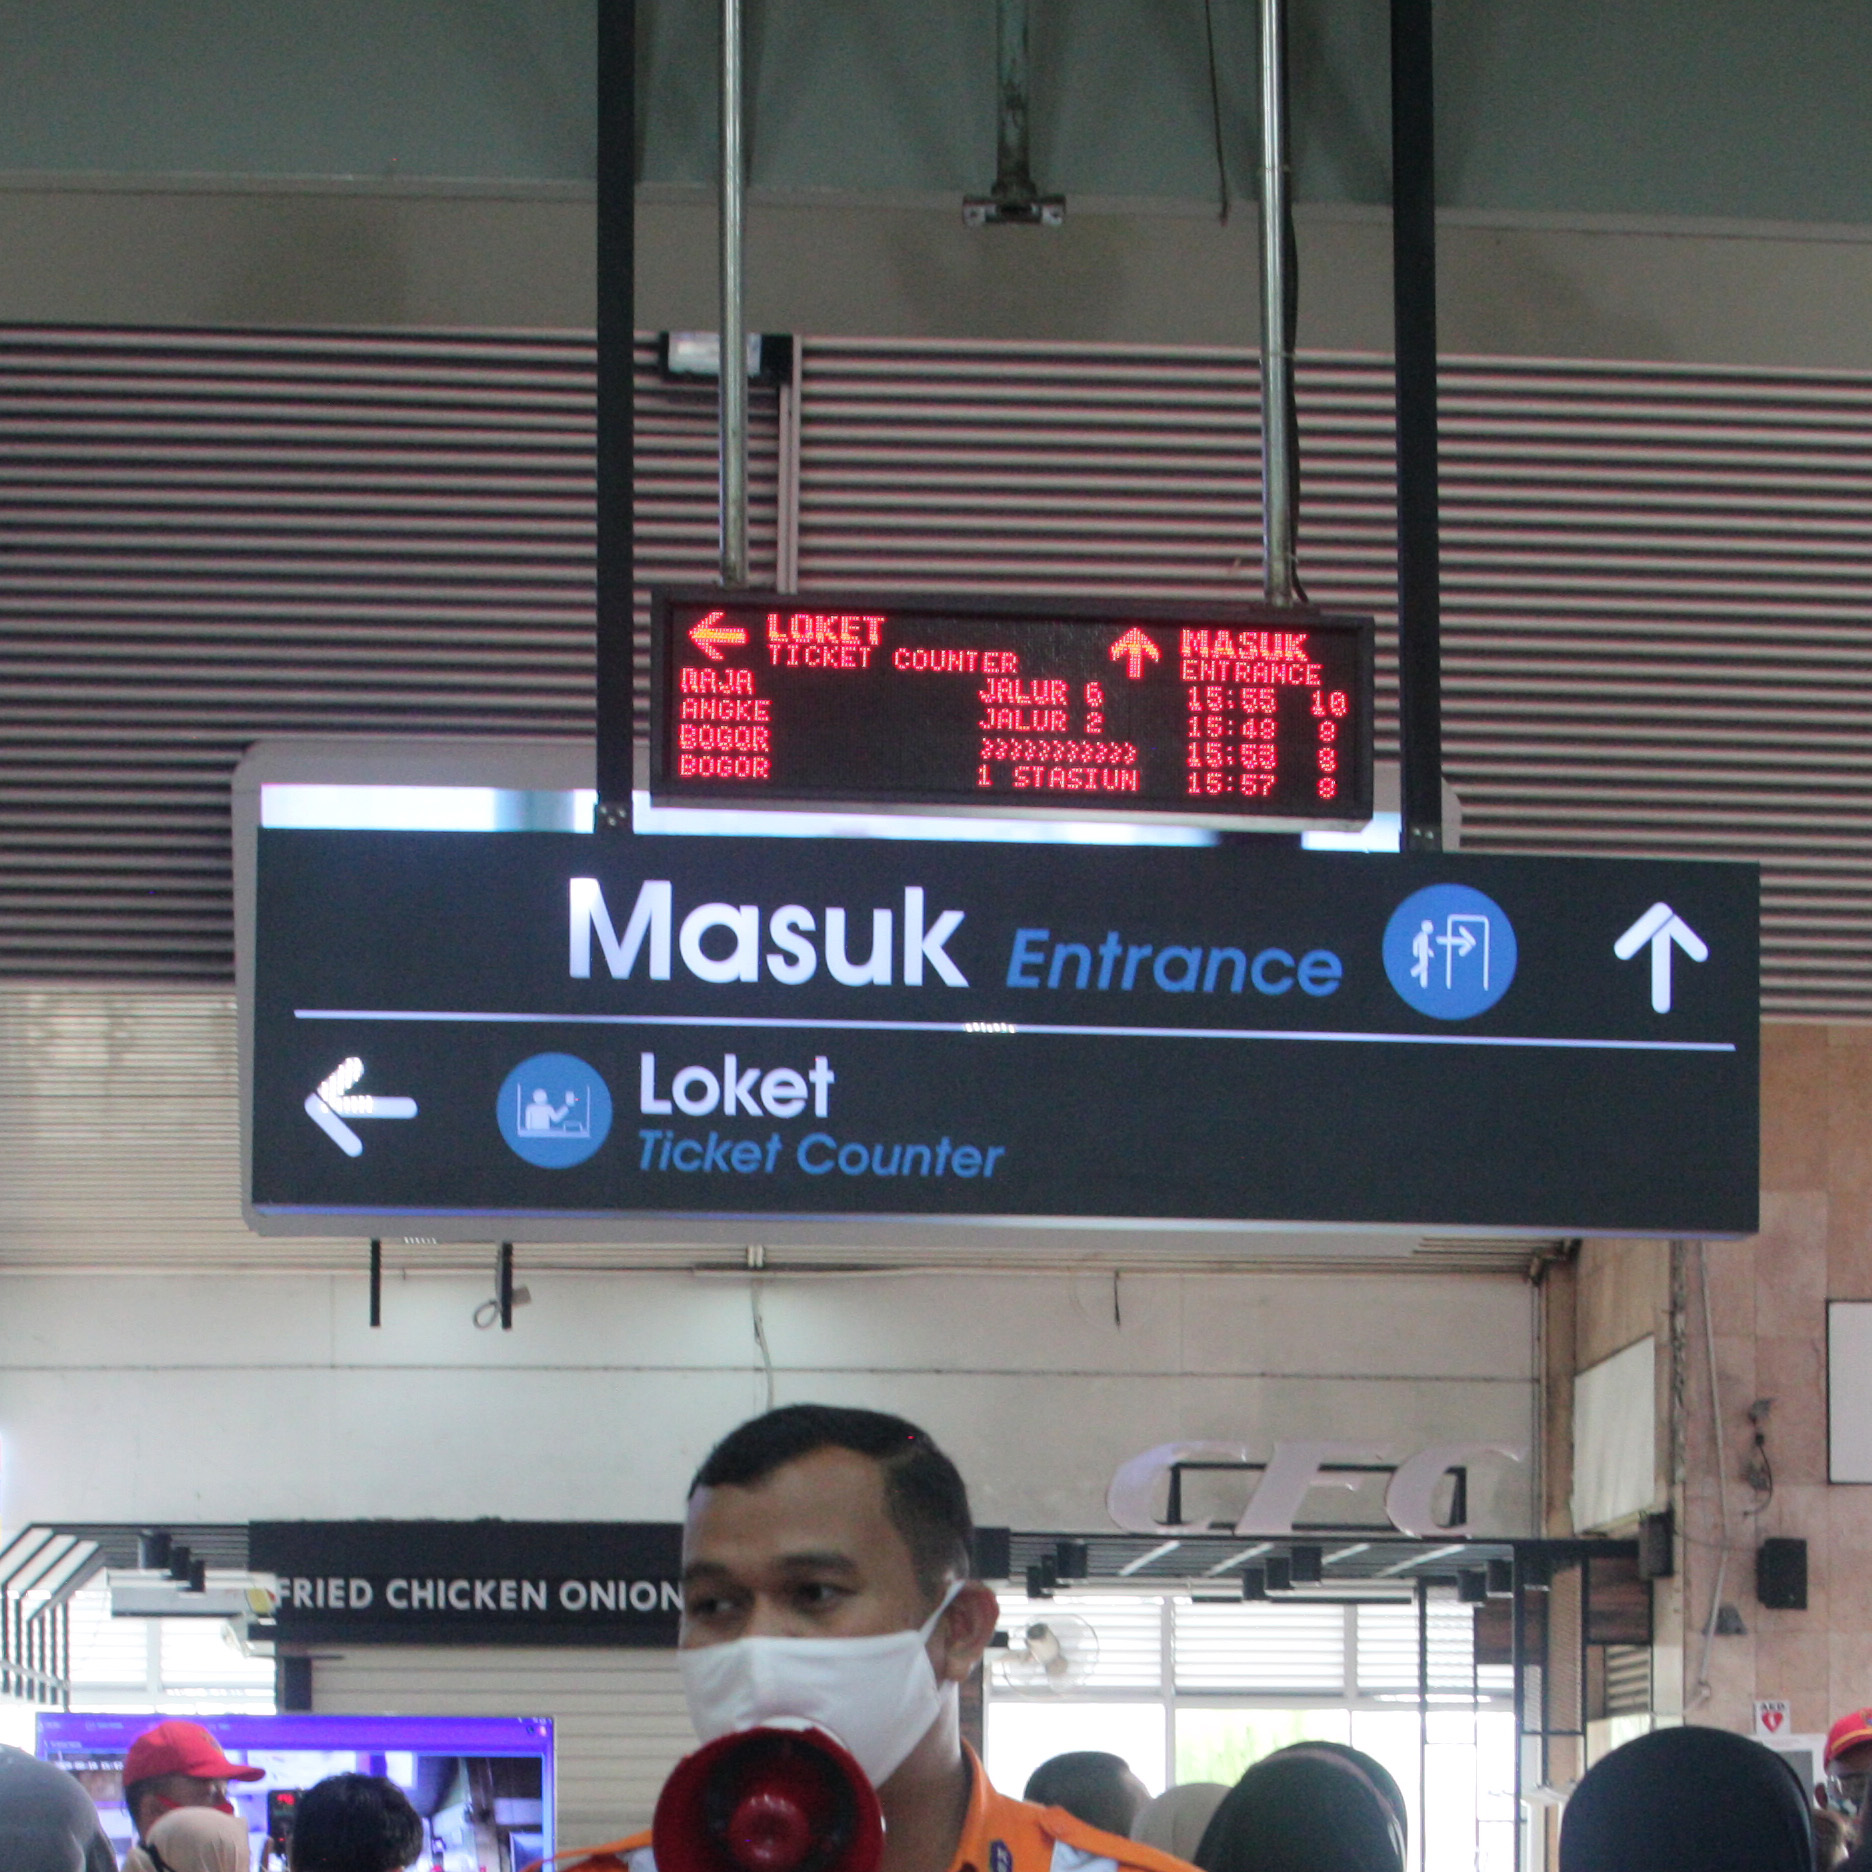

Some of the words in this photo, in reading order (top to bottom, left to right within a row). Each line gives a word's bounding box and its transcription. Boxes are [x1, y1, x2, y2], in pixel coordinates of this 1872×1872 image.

[766, 613, 886, 645] LOKET
[1181, 629, 1308, 661] MASUK
[767, 644, 871, 667] TICKET
[894, 648, 1019, 673] COUNTER
[1181, 660, 1322, 685] ENTRANCE
[681, 697, 771, 721] ANGKE
[979, 708, 1069, 732] JALUR
[1085, 711, 1104, 733] 2
[979, 678, 1069, 705] JALUR
[1085, 681, 1104, 708] 6
[1187, 686, 1276, 714] 15:55
[1310, 690, 1348, 717] 10
[680, 723, 771, 752] BOGOR
[680, 754, 770, 778] BOGOR
[978, 764, 992, 788] 1
[1012, 765, 1140, 792] STASIUN
[1187, 772, 1276, 796] 15:57
[568, 878, 970, 988] Masuk
[1006, 927, 1343, 996] Entrance
[640, 1052, 835, 1118] Loket
[638, 1129, 783, 1173] Ticket
[796, 1132, 1005, 1178] Counter
[275, 1577, 374, 1609] FRIED
[386, 1578, 548, 1611] CHICKEN
[559, 1580, 682, 1611] ONION
